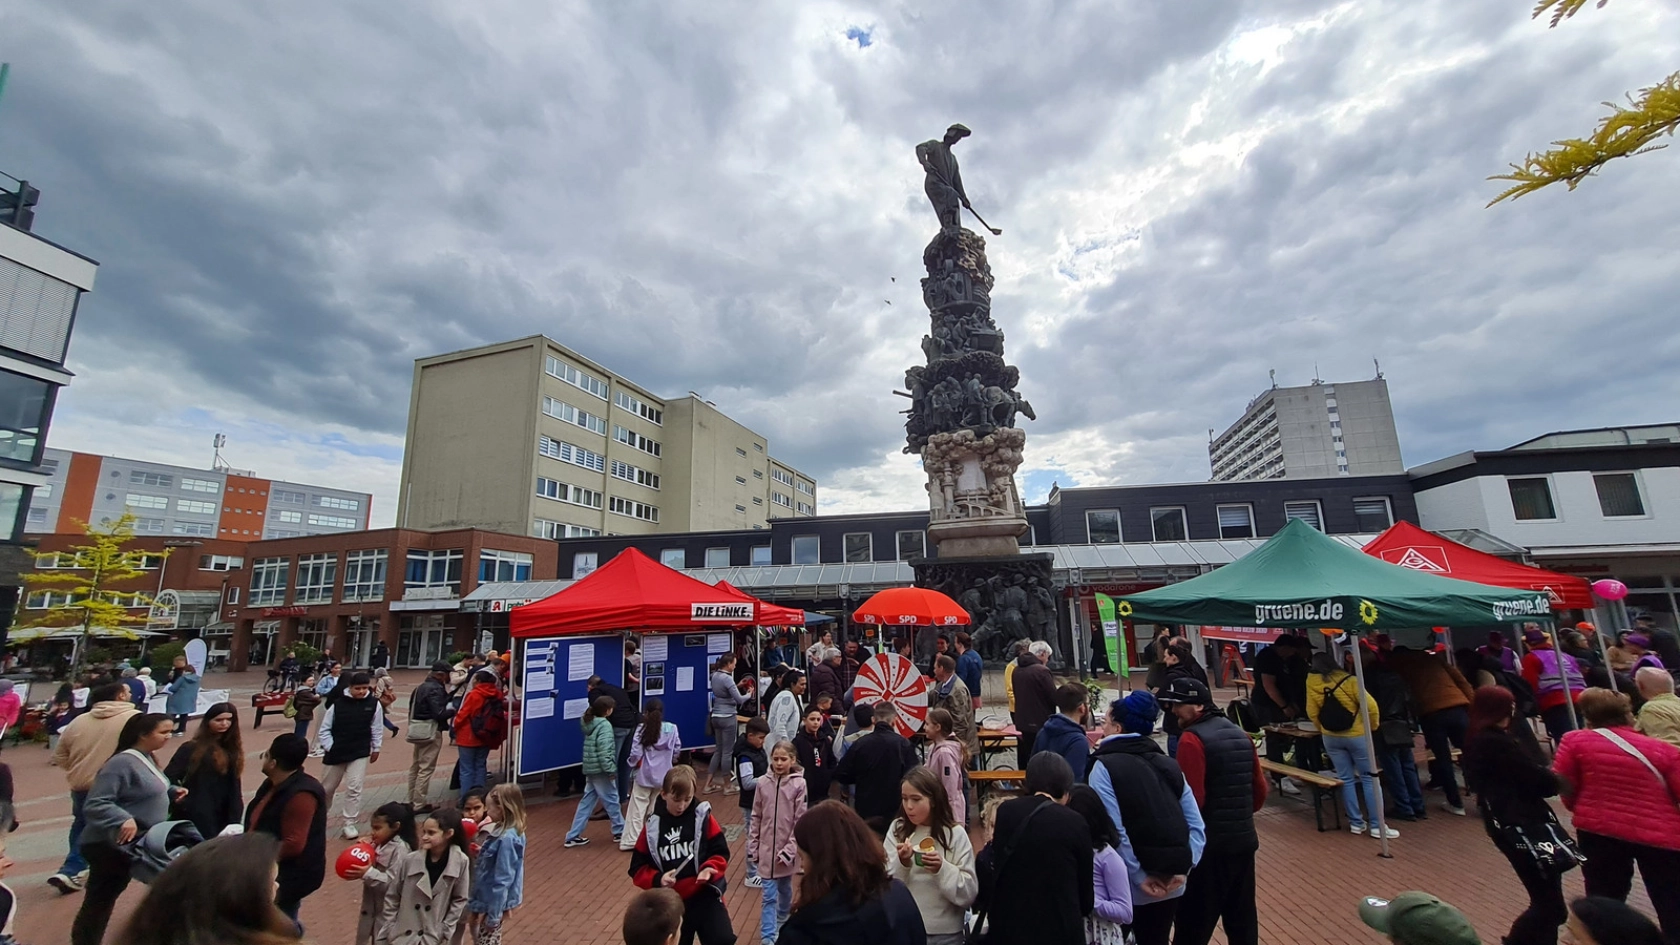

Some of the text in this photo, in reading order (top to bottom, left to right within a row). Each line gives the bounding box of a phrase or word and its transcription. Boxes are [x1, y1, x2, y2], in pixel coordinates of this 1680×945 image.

[1092, 584, 1136, 592] vodafone
[695, 606, 715, 617] DIE
[1255, 599, 1343, 624] gruene.de
[1493, 595, 1550, 621] gruene.de
[864, 614, 876, 623] SPD
[899, 615, 917, 624] SPD
[944, 616, 958, 625] SPD
[350, 847, 371, 862] SPD
